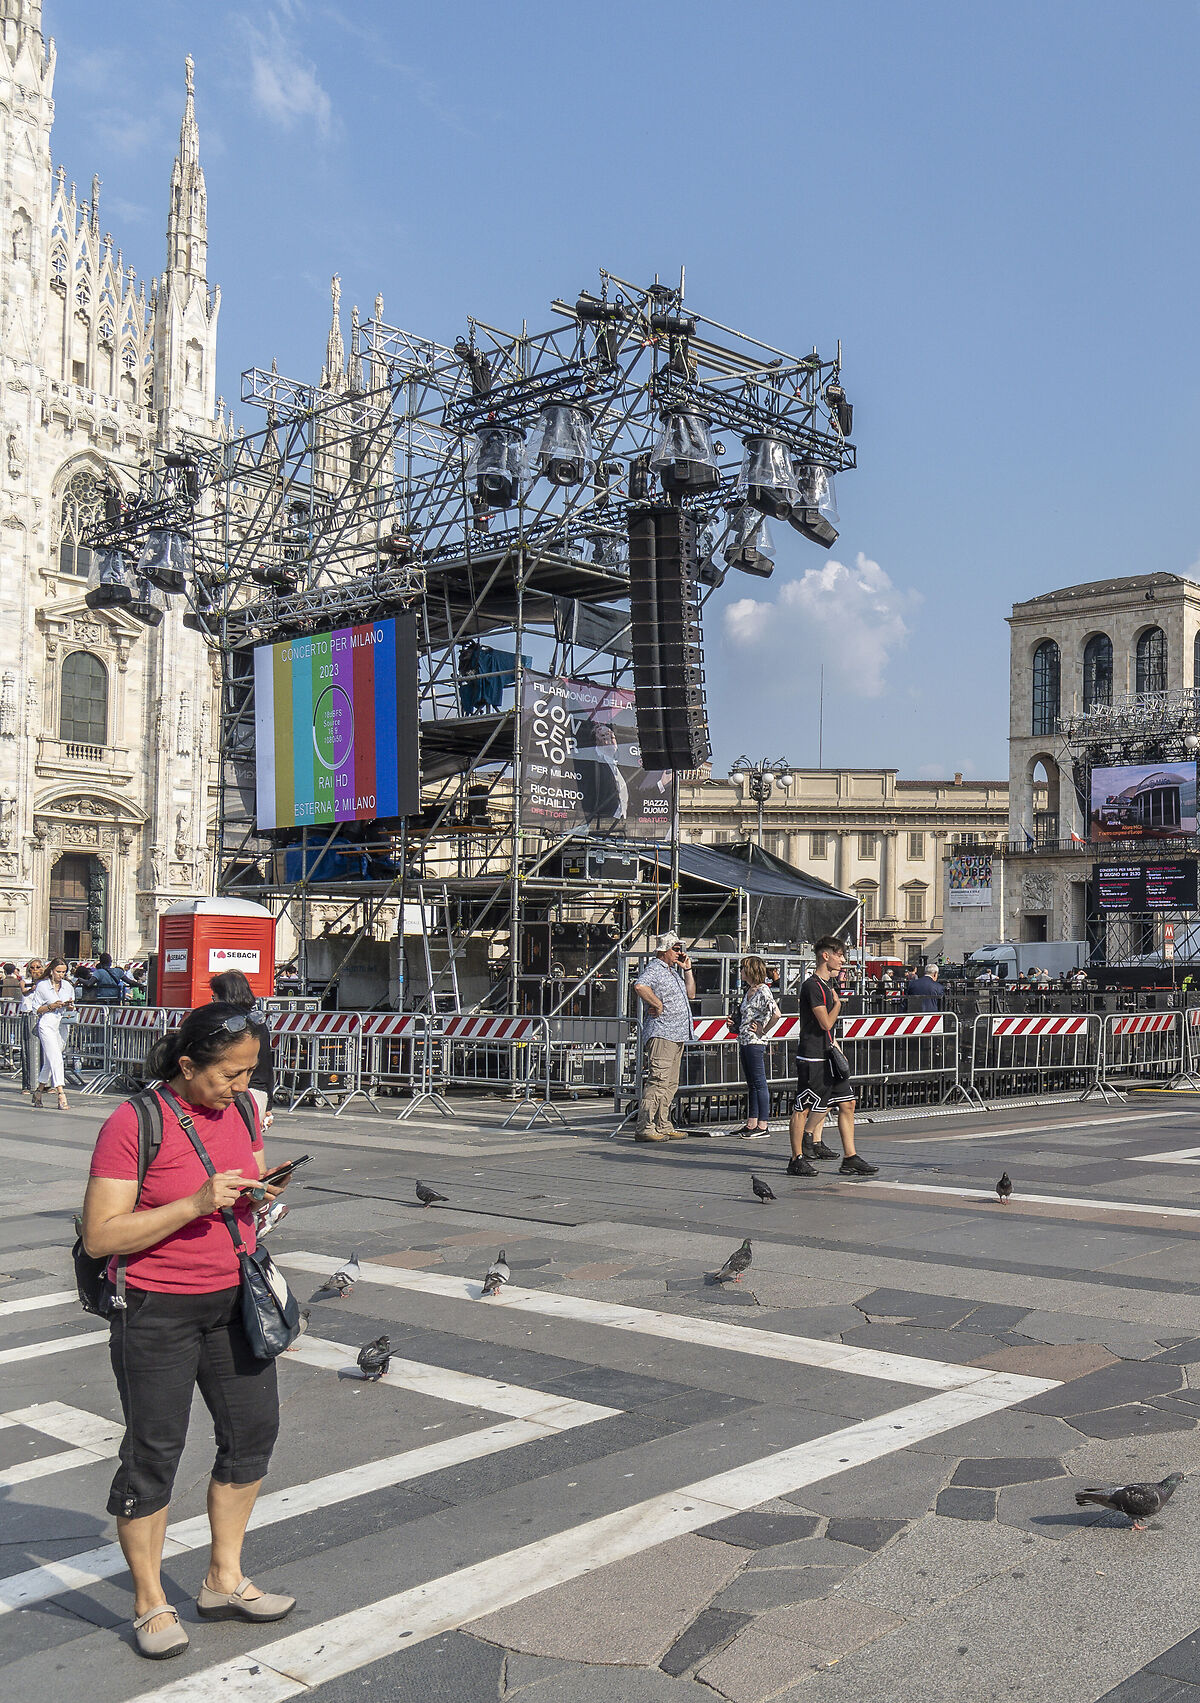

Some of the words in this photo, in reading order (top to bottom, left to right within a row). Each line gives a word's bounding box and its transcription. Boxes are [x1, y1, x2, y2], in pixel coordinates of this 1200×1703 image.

[281, 642, 328, 662] CONCERTO
[330, 637, 348, 652] PER
[350, 629, 384, 648] MILANO
[319, 663, 339, 679] 2023
[533, 682, 598, 704] FILARMONICA
[603, 698, 633, 710] DELLA
[531, 764, 548, 775] PER
[550, 768, 582, 781] MILANO
[318, 776, 333, 789] RAI
[335, 774, 348, 787] HD
[530, 783, 584, 801] RICCARDO
[294, 800, 333, 816] ESTERNA
[334, 800, 340, 812] 2
[342, 794, 376, 811] MILANO
[531, 795, 577, 810] CHAILLY
[643, 799, 669, 807] PIAZZA
[531, 807, 568, 819] DIRETTORE
[1165, 926, 1174, 937] M
[170, 953, 187, 961] SEBACH
[226, 951, 257, 959] SEBACH
